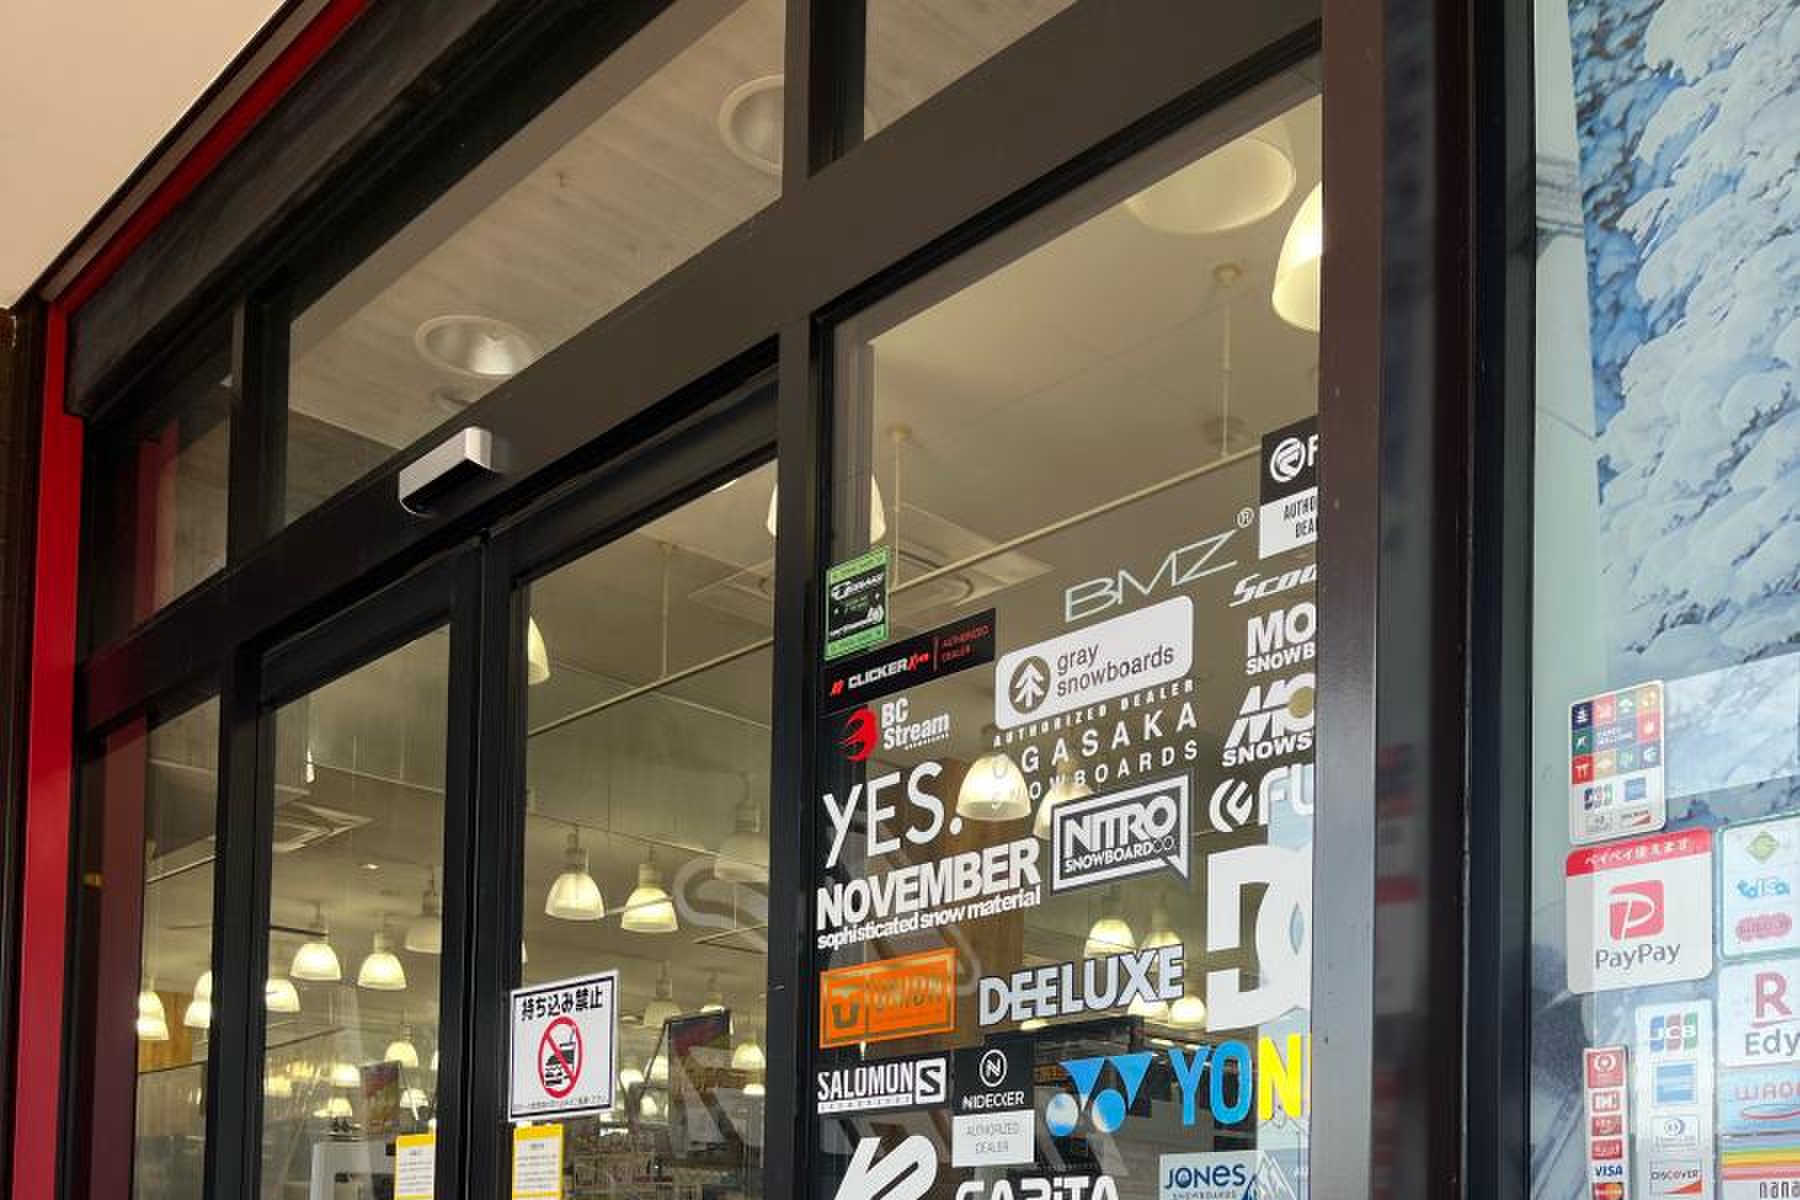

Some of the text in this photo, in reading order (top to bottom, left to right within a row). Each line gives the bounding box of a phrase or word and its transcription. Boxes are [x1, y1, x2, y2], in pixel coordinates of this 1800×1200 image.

[1065, 529, 1238, 623] BMZ
[847, 658, 910, 690] CLICKER
[1057, 644, 1100, 677] gray
[1057, 645, 1175, 698] snowboards
[1246, 641, 1316, 675] SNOWB
[881, 698, 909, 729] BC
[882, 713, 950, 751] Stream
[992, 702, 1107, 748] AUTHORIZED
[1121, 679, 1194, 712] DEALER
[1221, 730, 1314, 767] SNOWS
[1063, 795, 1178, 859] NITRO
[816, 836, 1042, 931] NOVEMBER
[817, 883, 1041, 951] sophisticated snow material
[1596, 943, 1681, 970] PayPay
[520, 985, 604, 1022] 持ち込み禁止
[978, 943, 1186, 1028] DEELUXE
[817, 1060, 914, 1102] SALOMON
[961, 1091, 1025, 1111] NIDECKER
[1594, 1164, 1623, 1177] VISA
[1651, 1168, 1700, 1181] DISCOVER
